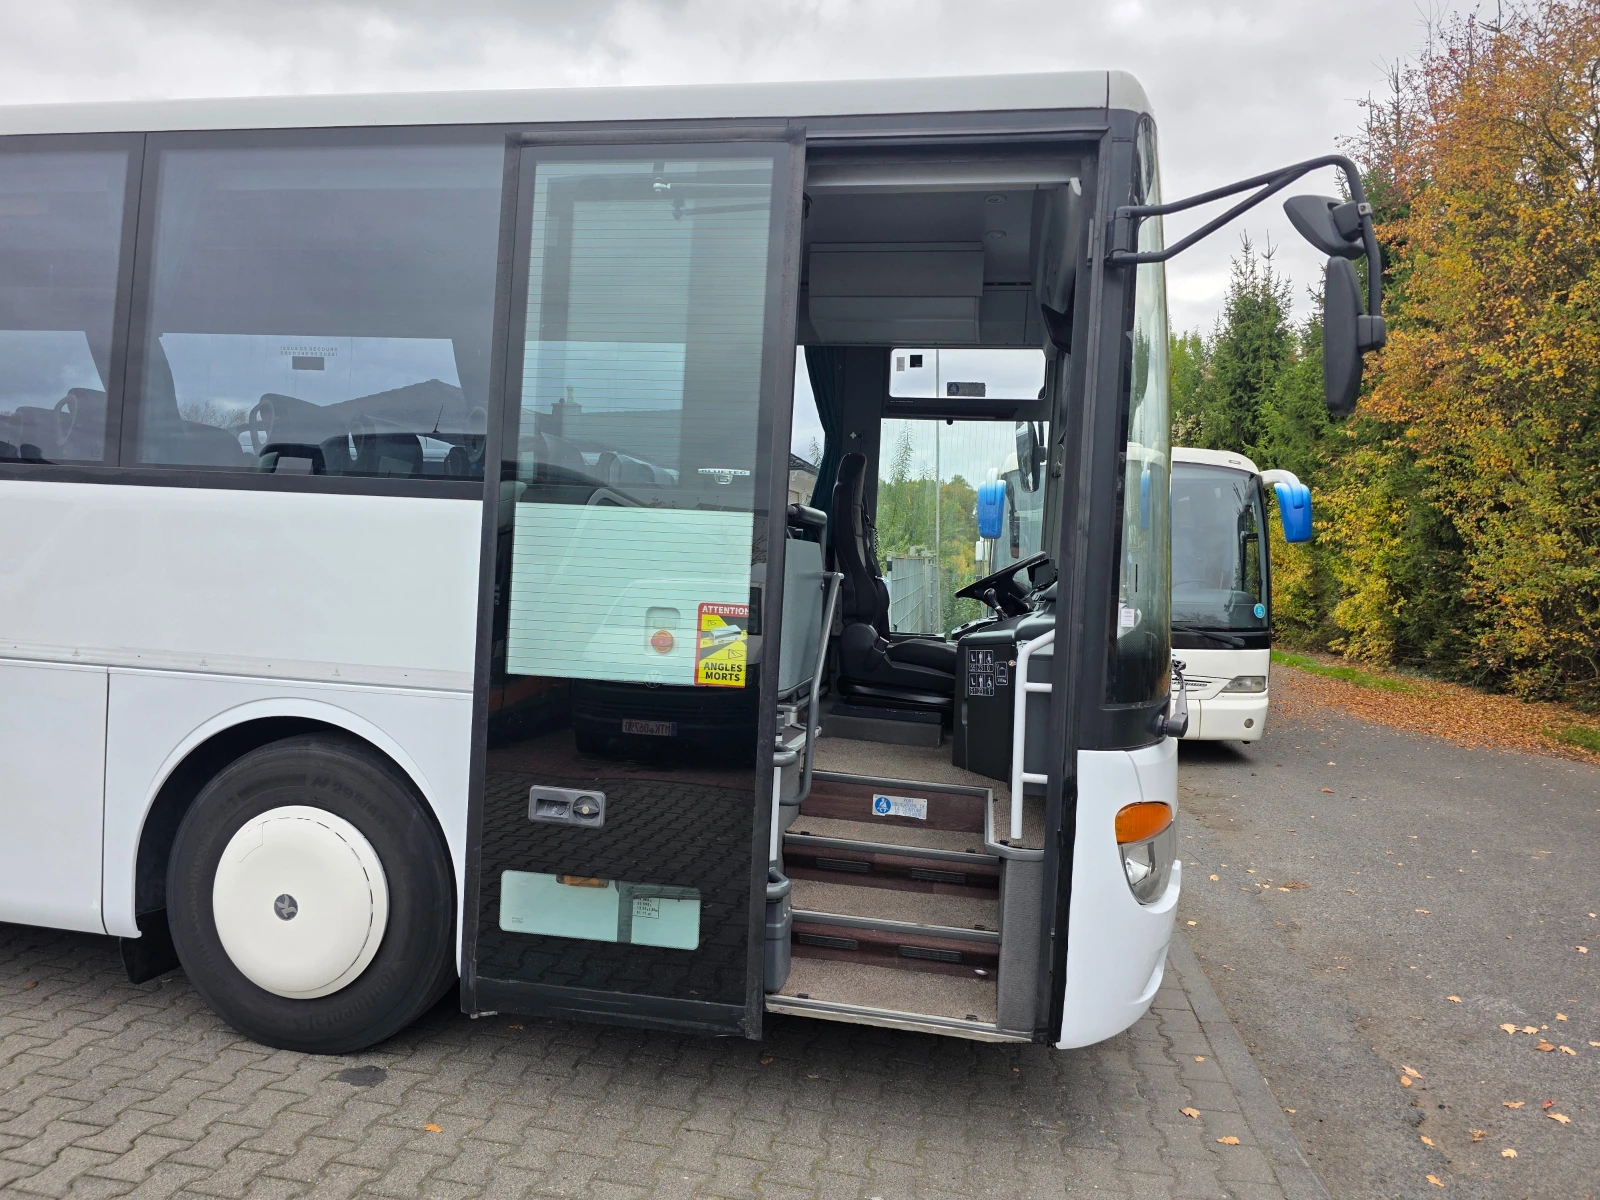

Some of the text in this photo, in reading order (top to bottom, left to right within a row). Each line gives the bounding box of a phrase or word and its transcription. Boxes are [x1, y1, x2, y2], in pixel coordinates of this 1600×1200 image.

[702, 605, 749, 615] ATTENTION
[703, 662, 743, 672] ANGLES
[705, 671, 740, 682] MORTS
